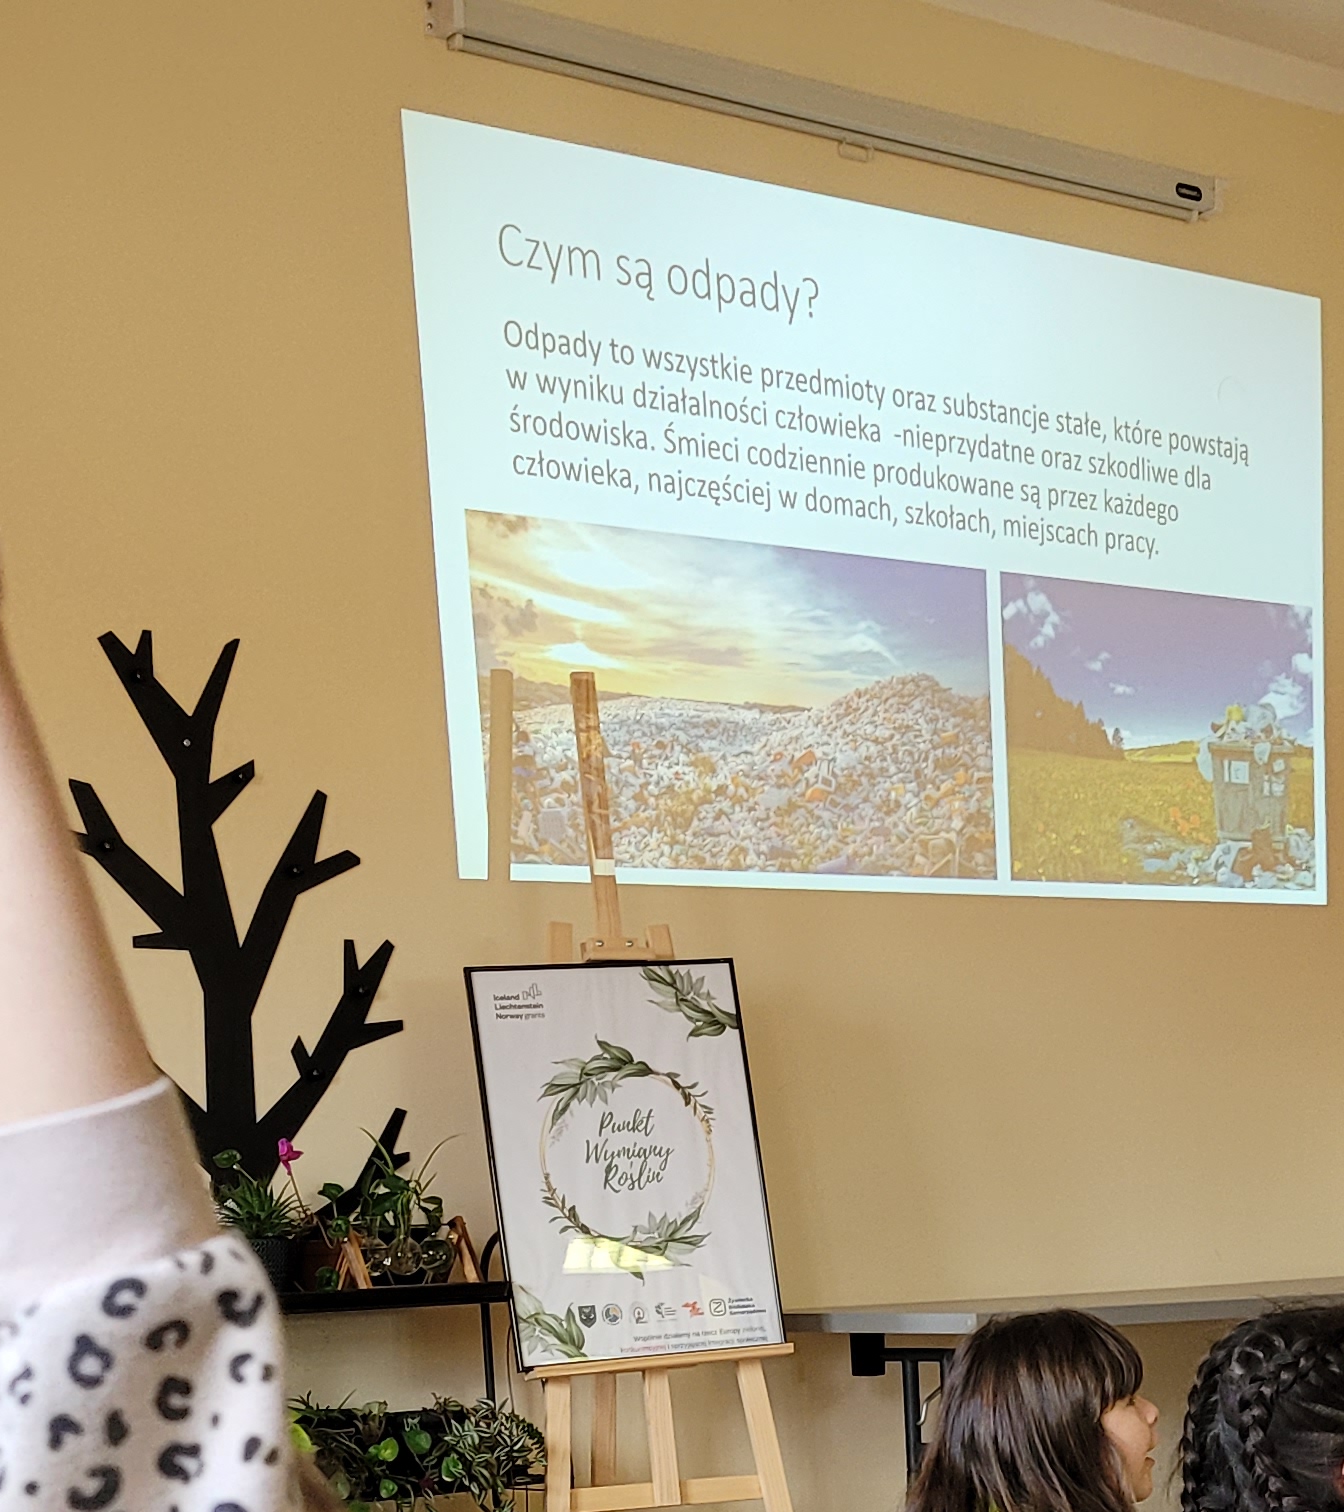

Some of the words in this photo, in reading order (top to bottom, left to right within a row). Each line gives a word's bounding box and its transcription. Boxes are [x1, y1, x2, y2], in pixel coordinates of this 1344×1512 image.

[499, 223, 601, 285] Czym
[615, 254, 655, 302] są
[667, 257, 820, 326] odpady?
[503, 320, 602, 367] Odpady
[609, 338, 635, 366] to
[642, 347, 753, 384] wszystkie
[761, 366, 886, 411] przedmioty
[892, 387, 937, 413] oraz
[942, 392, 1050, 434] substancje
[1055, 411, 1107, 444] stałe,
[1113, 415, 1163, 448] które
[1168, 431, 1250, 467] powstają
[505, 368, 528, 391] w
[535, 373, 624, 404] wyniku
[632, 380, 768, 427] działalności
[775, 404, 881, 443] człowieka
[893, 423, 1035, 465] -nieprzydatne
[1041, 448, 1083, 472] oraz
[1088, 451, 1179, 486] szkodliwe
[1184, 464, 1212, 491] dla
[509, 403, 656, 452] środowiska.
[663, 420, 740, 463] Śmieci
[747, 442, 866, 480] codziennie
[873, 461, 1015, 501] produkowane
[1020, 483, 1042, 510] są
[1047, 486, 1098, 512] przez
[1104, 487, 1179, 526] każdego
[512, 449, 640, 495] człowieka,
[648, 469, 771, 513] najczęściej
[778, 488, 798, 510] w
[805, 485, 899, 528] domach,
[905, 500, 997, 540] szkołach,
[1003, 514, 1099, 548] miejscach
[1104, 530, 1159, 560] pracy.
[493, 993, 520, 1001] Iceland
[495, 1012, 524, 1020] Norway
[585, 1138, 675, 1172] Wymiany
[598, 1108, 655, 1137] Punkt
[603, 1160, 664, 1194] Roślin
